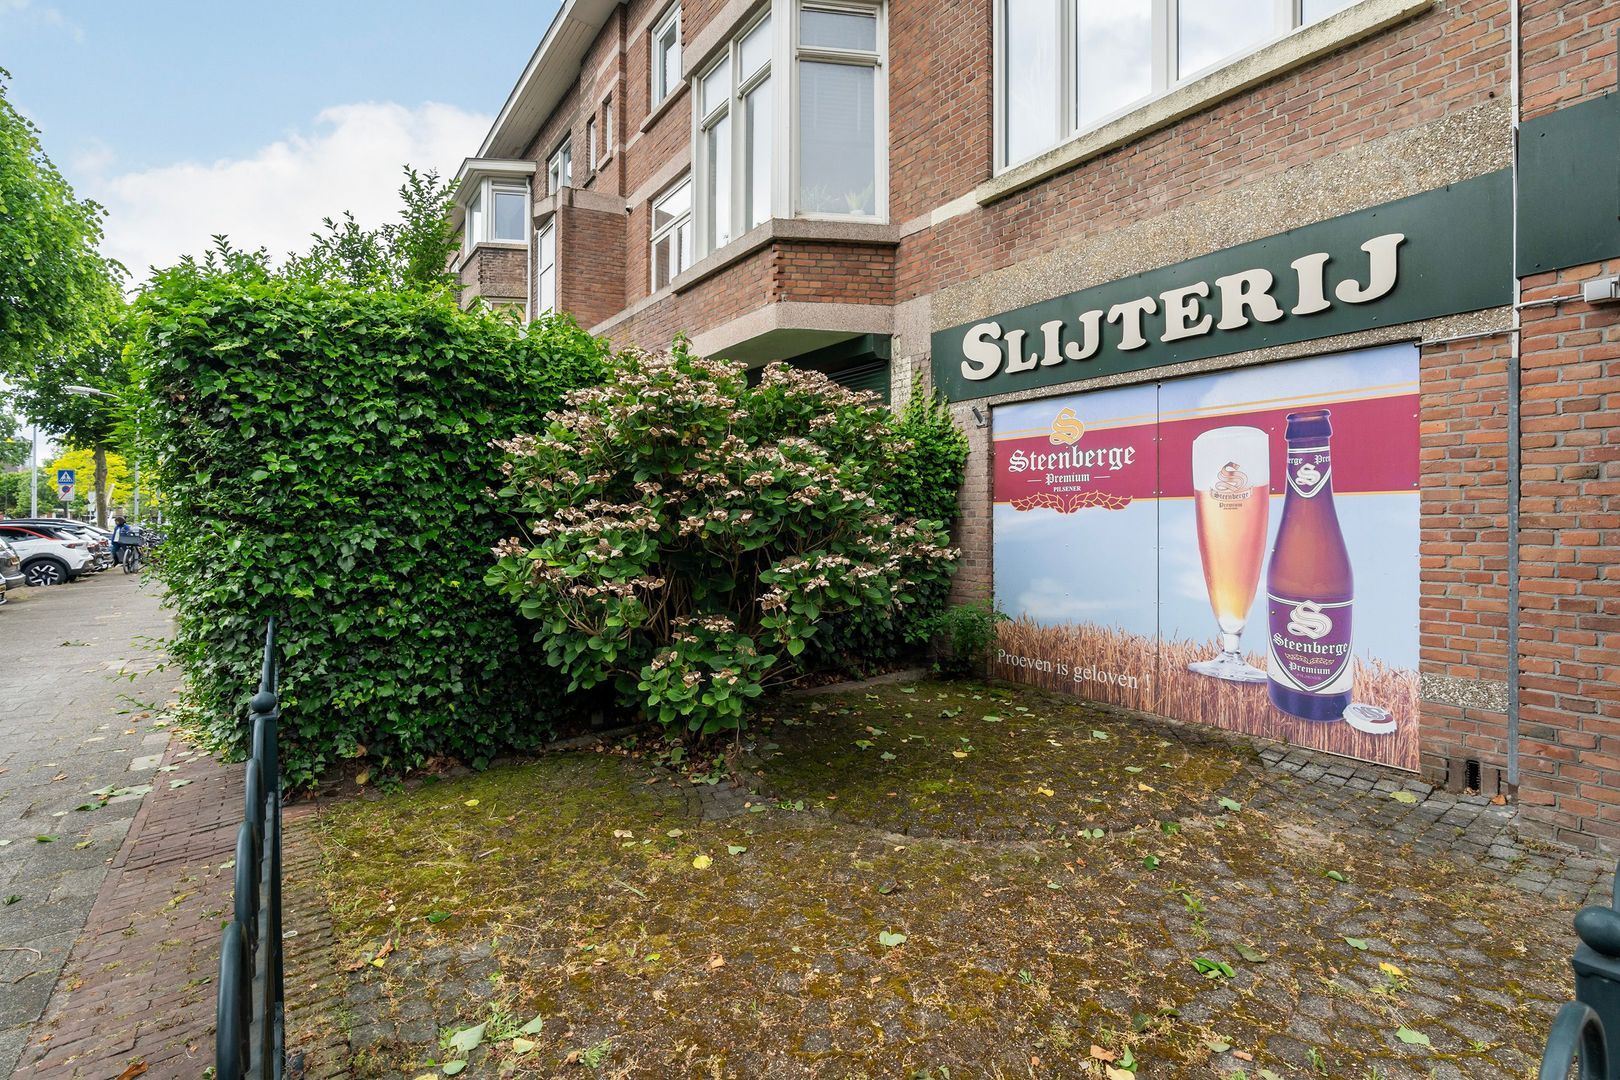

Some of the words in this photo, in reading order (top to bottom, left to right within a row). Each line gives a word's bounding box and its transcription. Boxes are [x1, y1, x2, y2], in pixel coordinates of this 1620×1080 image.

[960, 232, 1406, 380] SLIJTERIJ
[1008, 445, 1136, 473] Steenberge
[1045, 472, 1090, 486] Premium
[1272, 632, 1349, 656] Steenberge
[997, 648, 1052, 673] Proeven
[1056, 658, 1069, 676] is
[1073, 664, 1138, 689] geloven
[1289, 661, 1331, 675] Premium
